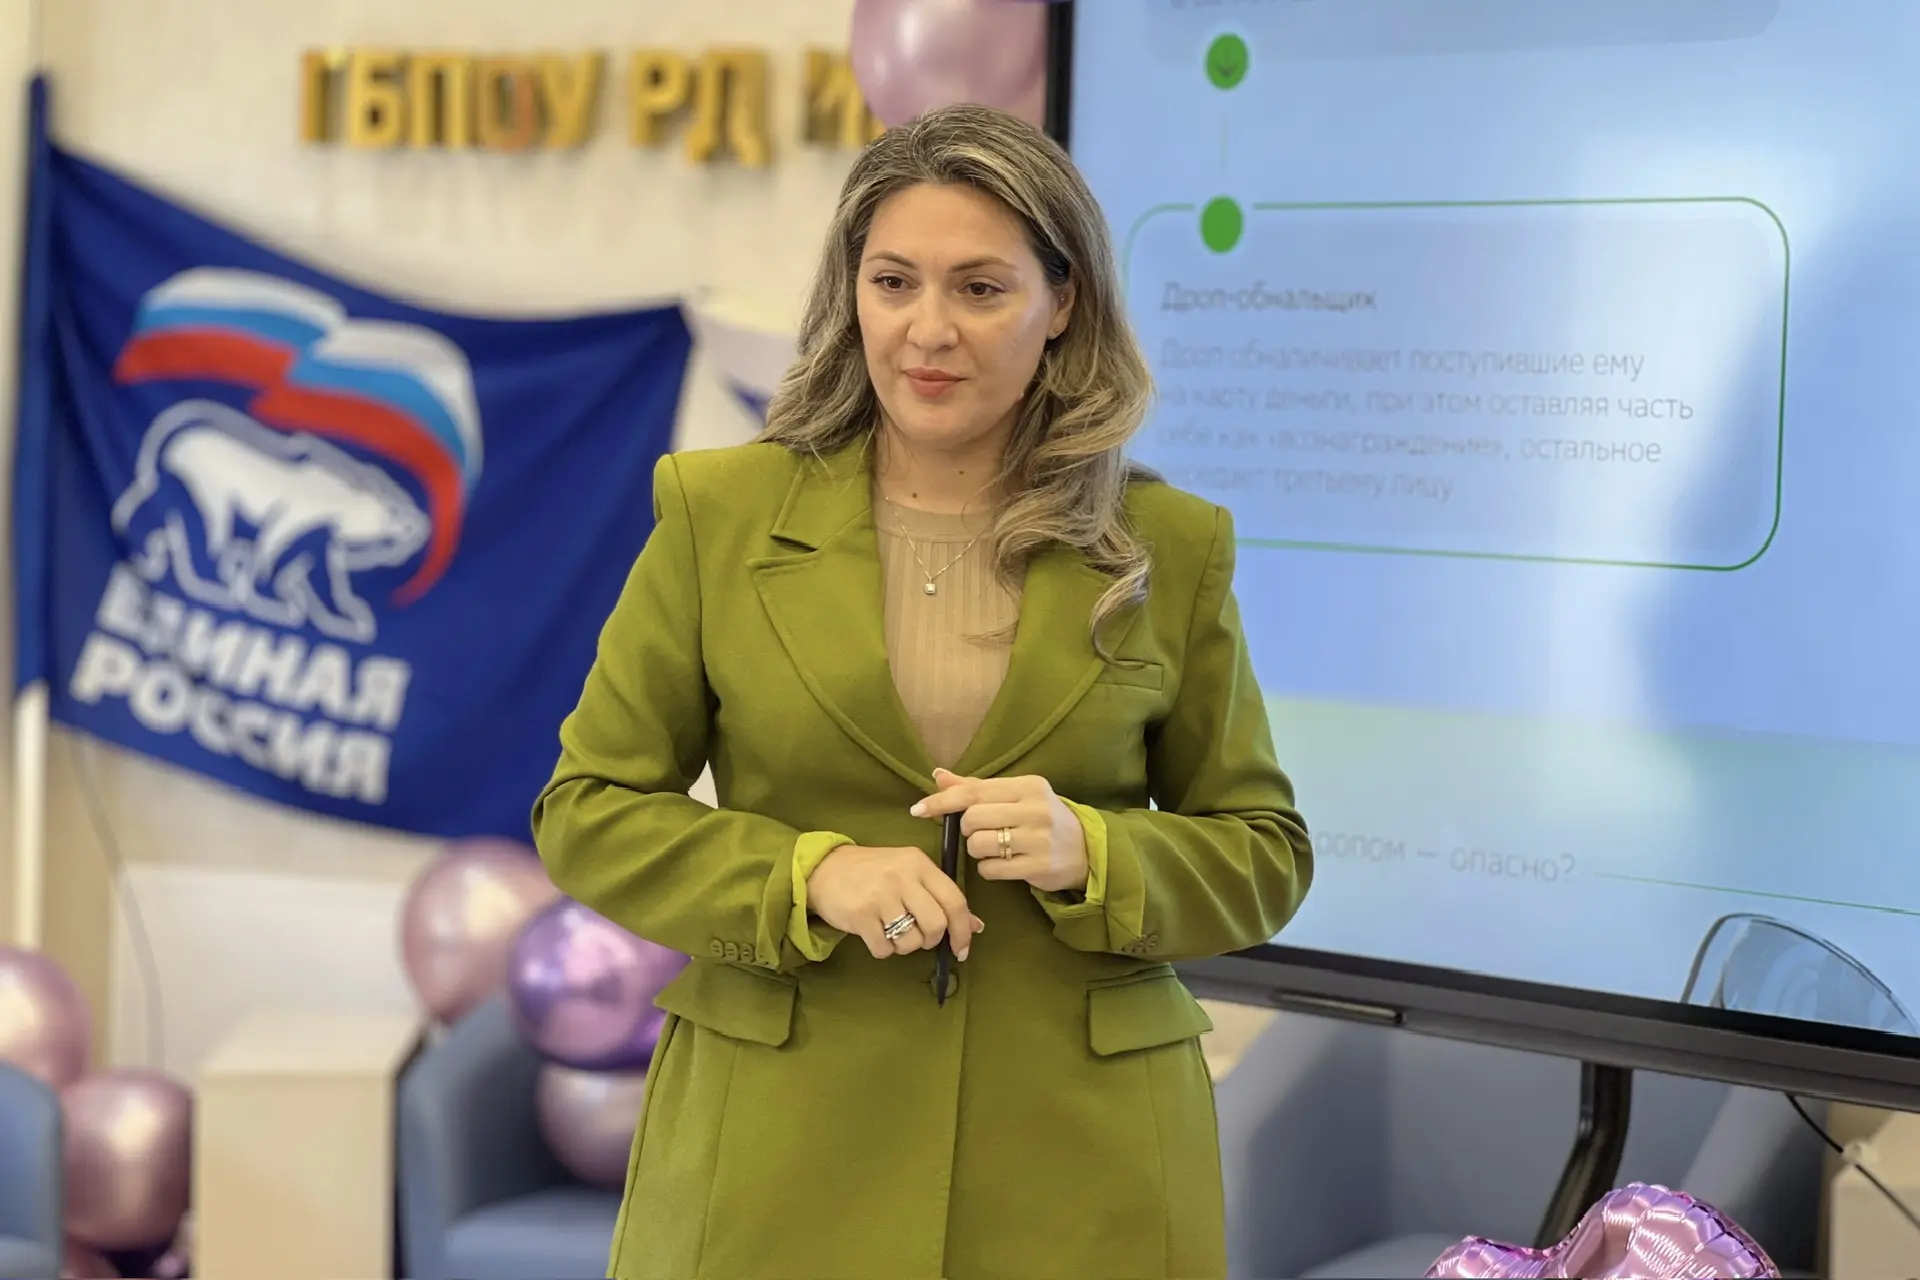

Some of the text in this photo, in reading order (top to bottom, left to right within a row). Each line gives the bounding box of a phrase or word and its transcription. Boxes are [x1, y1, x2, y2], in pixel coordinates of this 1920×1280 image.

[302, 48, 602, 152] ГБПОУ
[629, 47, 771, 168] РД
[1409, 350, 1584, 380] поступившие
[1593, 353, 1645, 382] ему
[1488, 393, 1609, 418] оставляя
[1617, 397, 1694, 421] часть
[1519, 437, 1662, 463] остальное
[1314, 831, 1405, 862] ропом
[1450, 846, 1576, 883] опасно?
